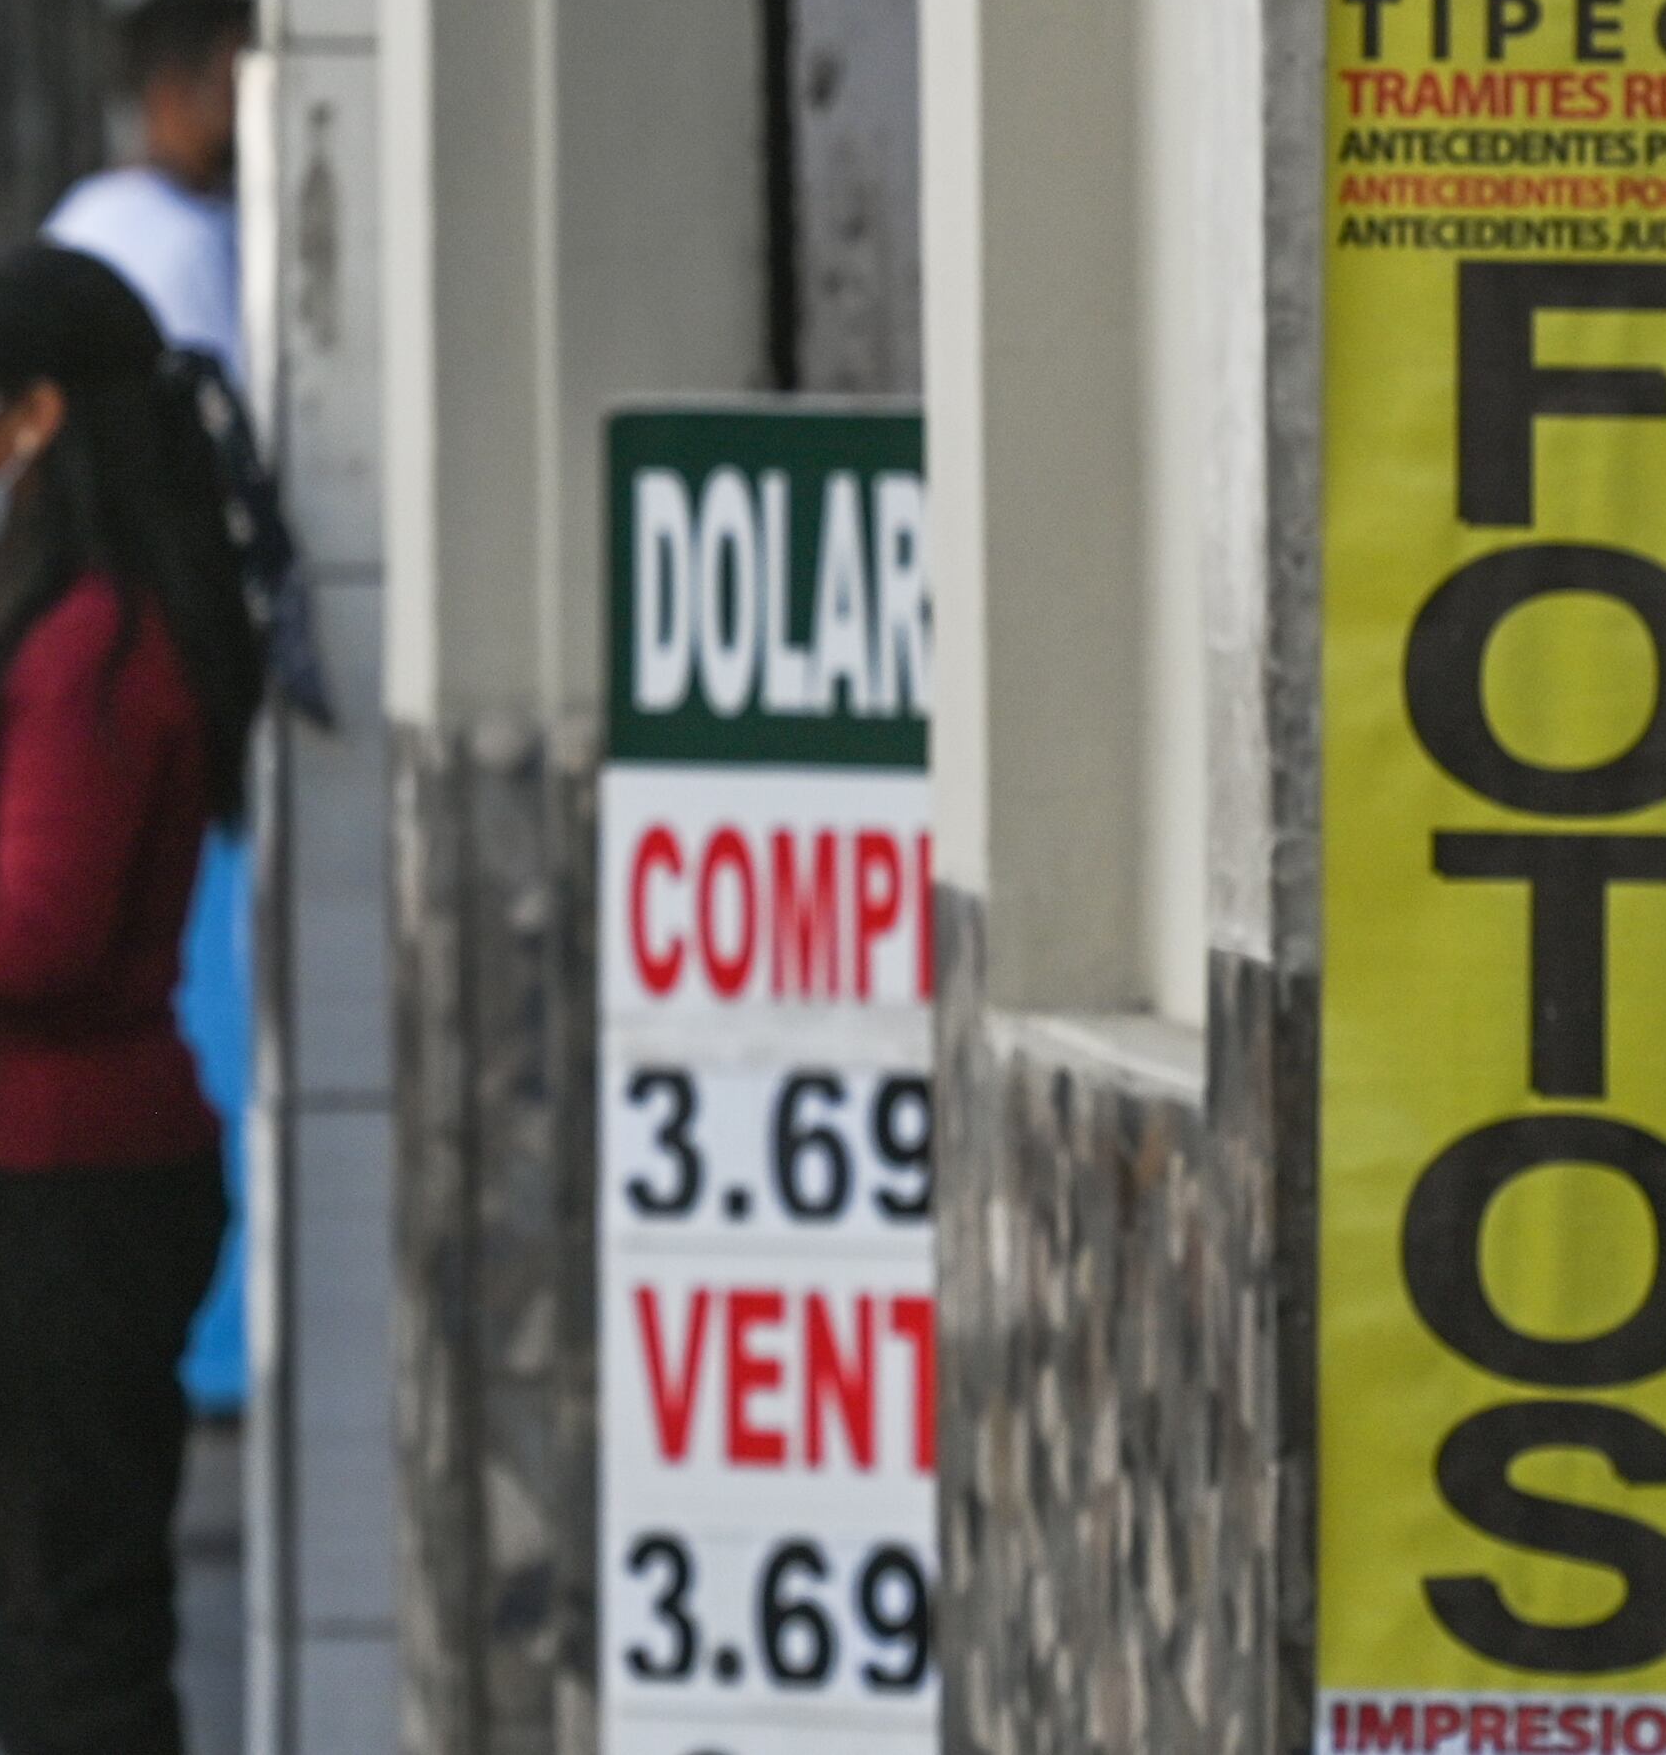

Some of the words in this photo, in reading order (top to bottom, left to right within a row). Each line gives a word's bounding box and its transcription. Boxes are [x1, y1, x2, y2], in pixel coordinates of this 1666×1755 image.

[1339, 69, 1611, 121] TRAMITES
[1339, 128, 1639, 168] ANTECEDENTES
[1338, 174, 1609, 211] ANTECEDENTES
[1337, 215, 1611, 253] ANTECEDENTES
[631, 467, 931, 715] DOLAR
[623, 1068, 934, 1225] 3.69
[623, 1531, 934, 1692] 3.69
